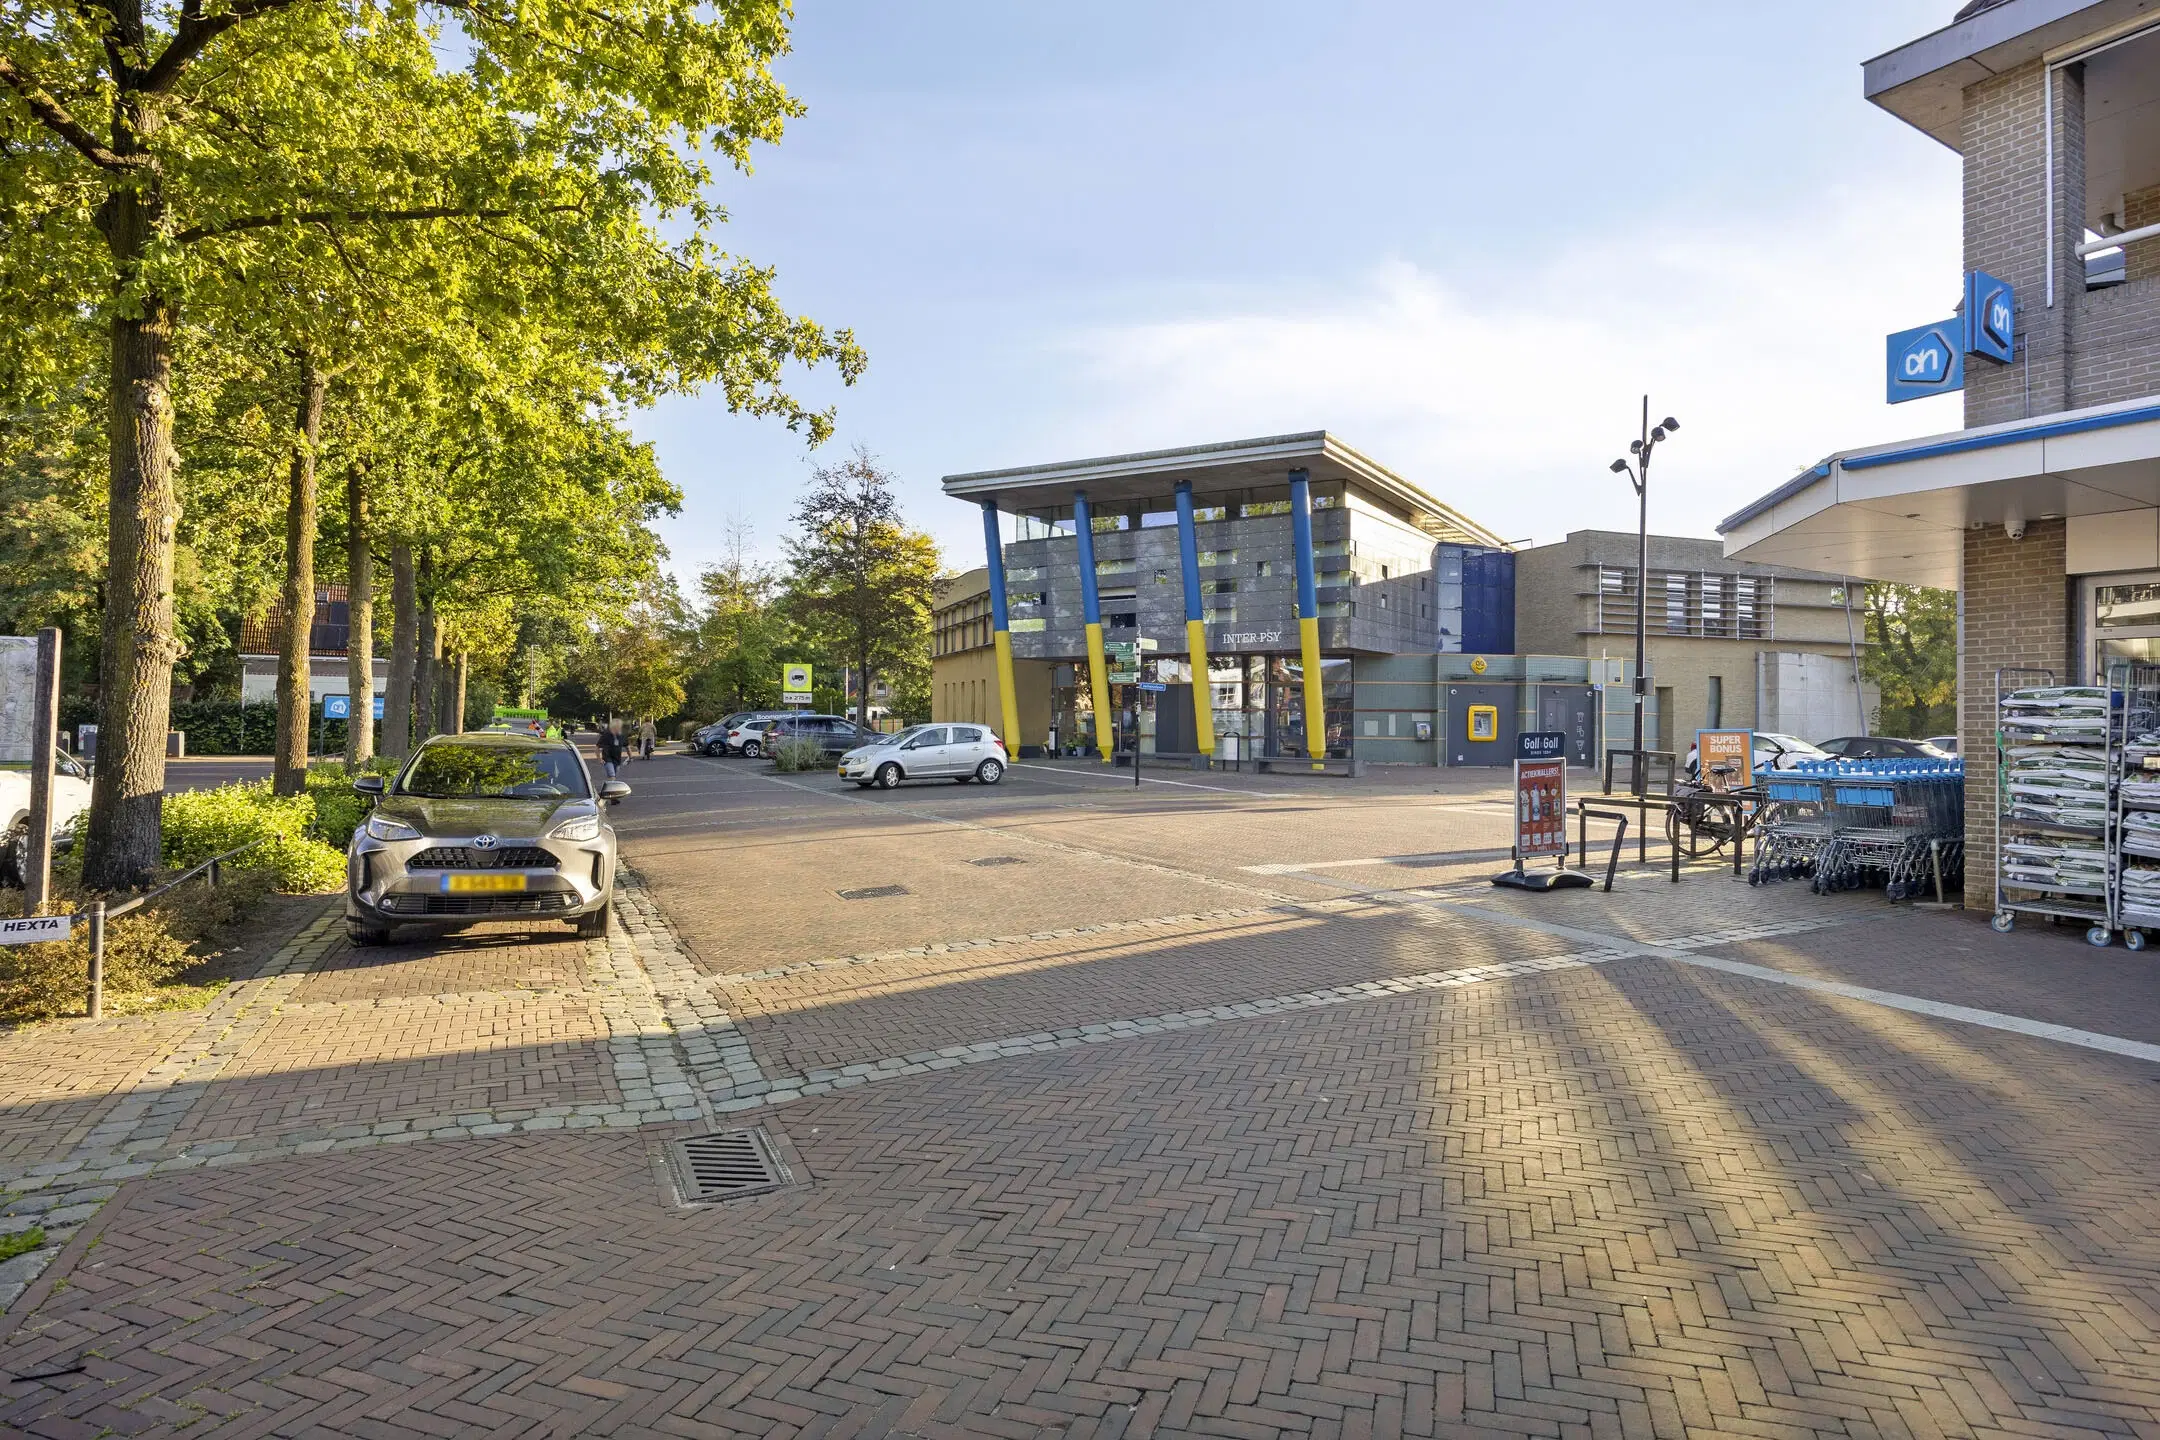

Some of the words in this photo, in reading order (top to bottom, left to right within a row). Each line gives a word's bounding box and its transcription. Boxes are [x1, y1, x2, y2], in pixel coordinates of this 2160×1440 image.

[1222, 631, 1281, 644] INTER-PSY
[1524, 737, 1540, 749] Gall
[1543, 737, 1559, 748] Gall
[1710, 735, 1741, 744] SUPER
[1710, 745, 1742, 753] BONUS
[3, 919, 59, 932] HEXTA
